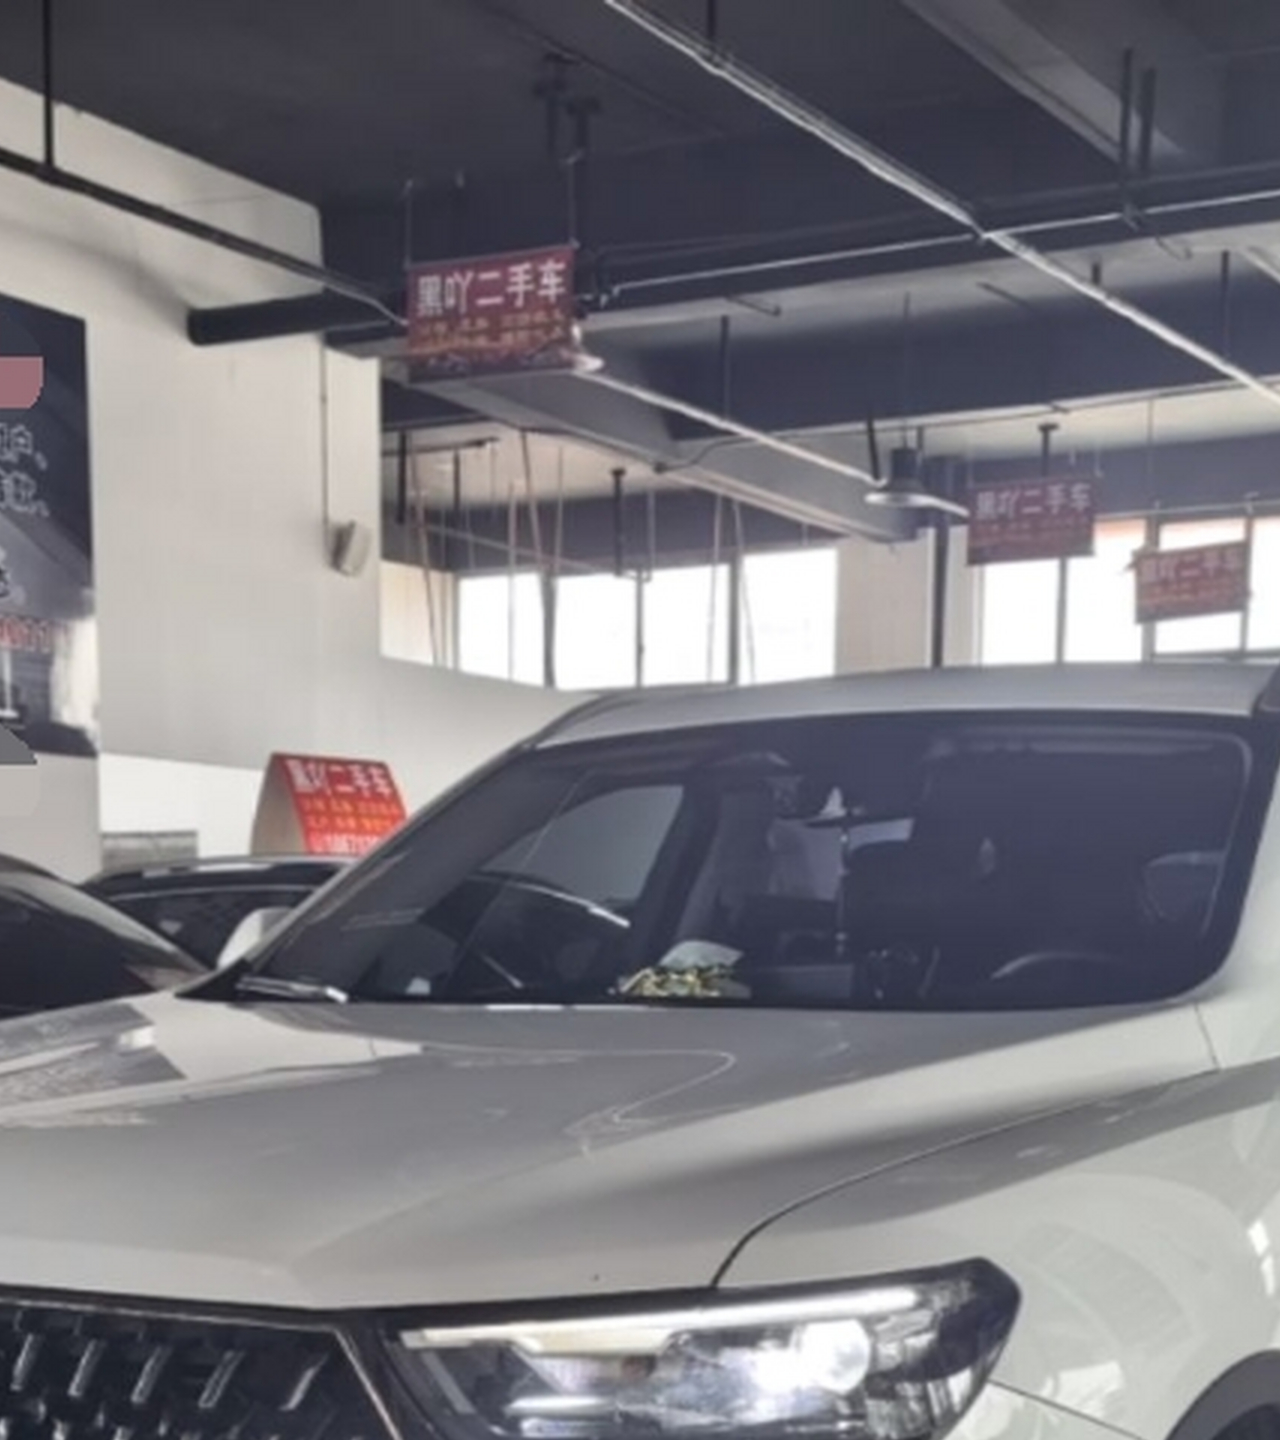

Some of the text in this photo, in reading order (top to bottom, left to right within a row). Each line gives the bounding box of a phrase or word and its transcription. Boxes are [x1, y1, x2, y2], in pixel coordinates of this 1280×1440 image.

[417, 259, 566, 318] 黑吖二手车
